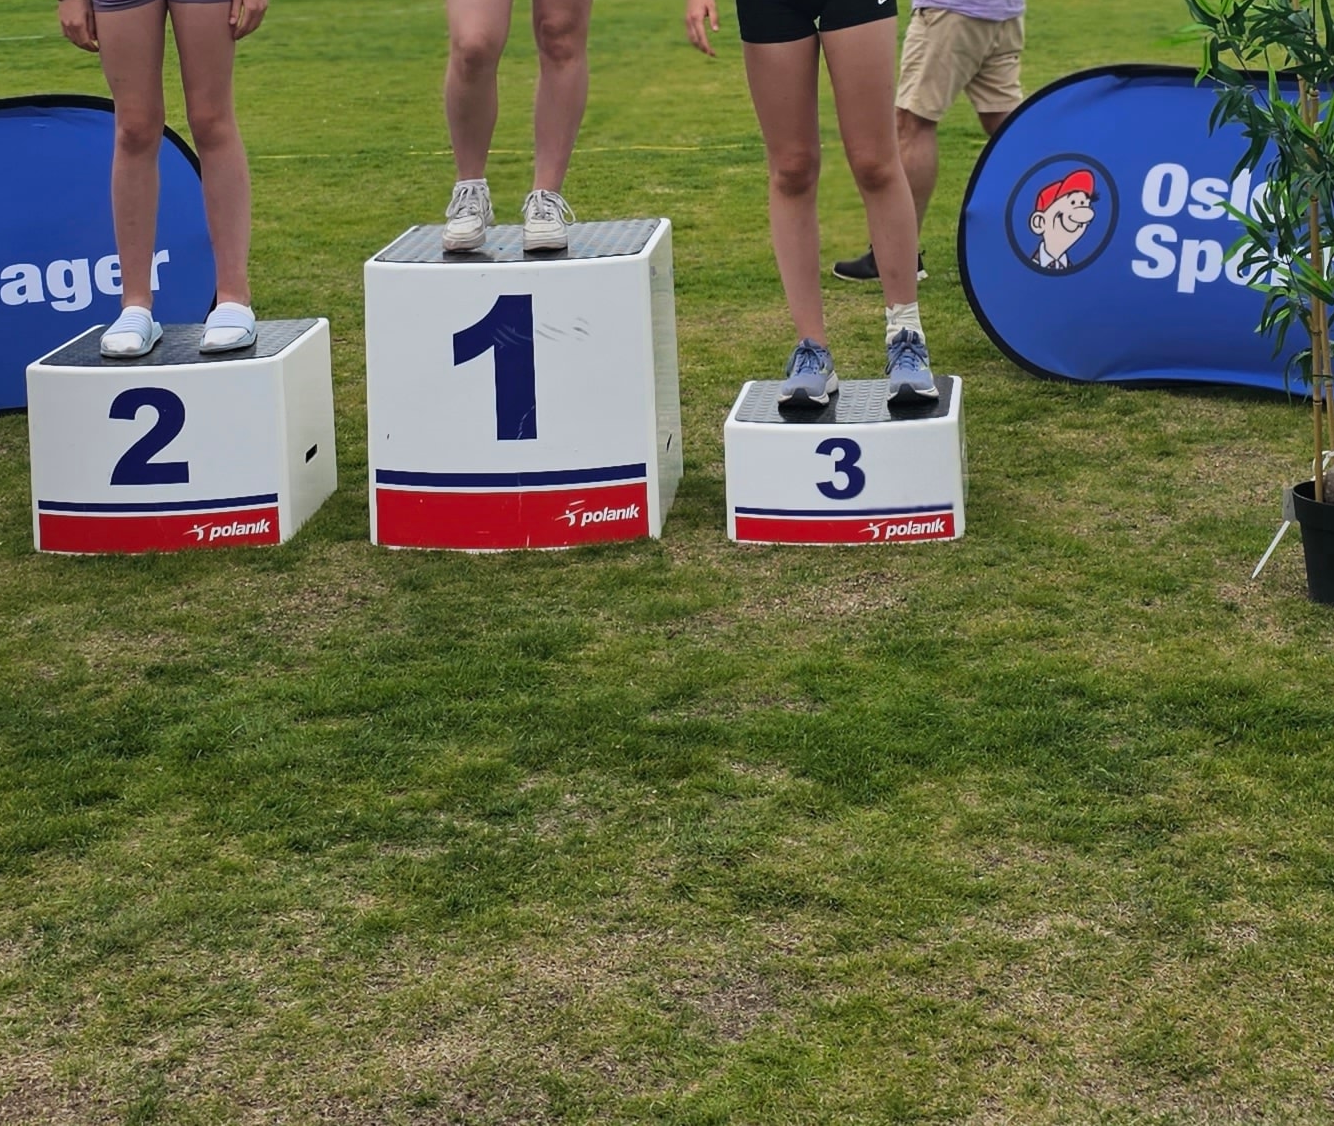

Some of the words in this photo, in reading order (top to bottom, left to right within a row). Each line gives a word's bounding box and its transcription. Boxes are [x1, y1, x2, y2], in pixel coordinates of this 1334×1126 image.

[453, 294, 537, 441] 1
[109, 387, 189, 486] 2
[816, 438, 866, 500] 3
[209, 519, 270, 541] polanik
[581, 504, 640, 527] polanik
[885, 518, 945, 540] polanik
